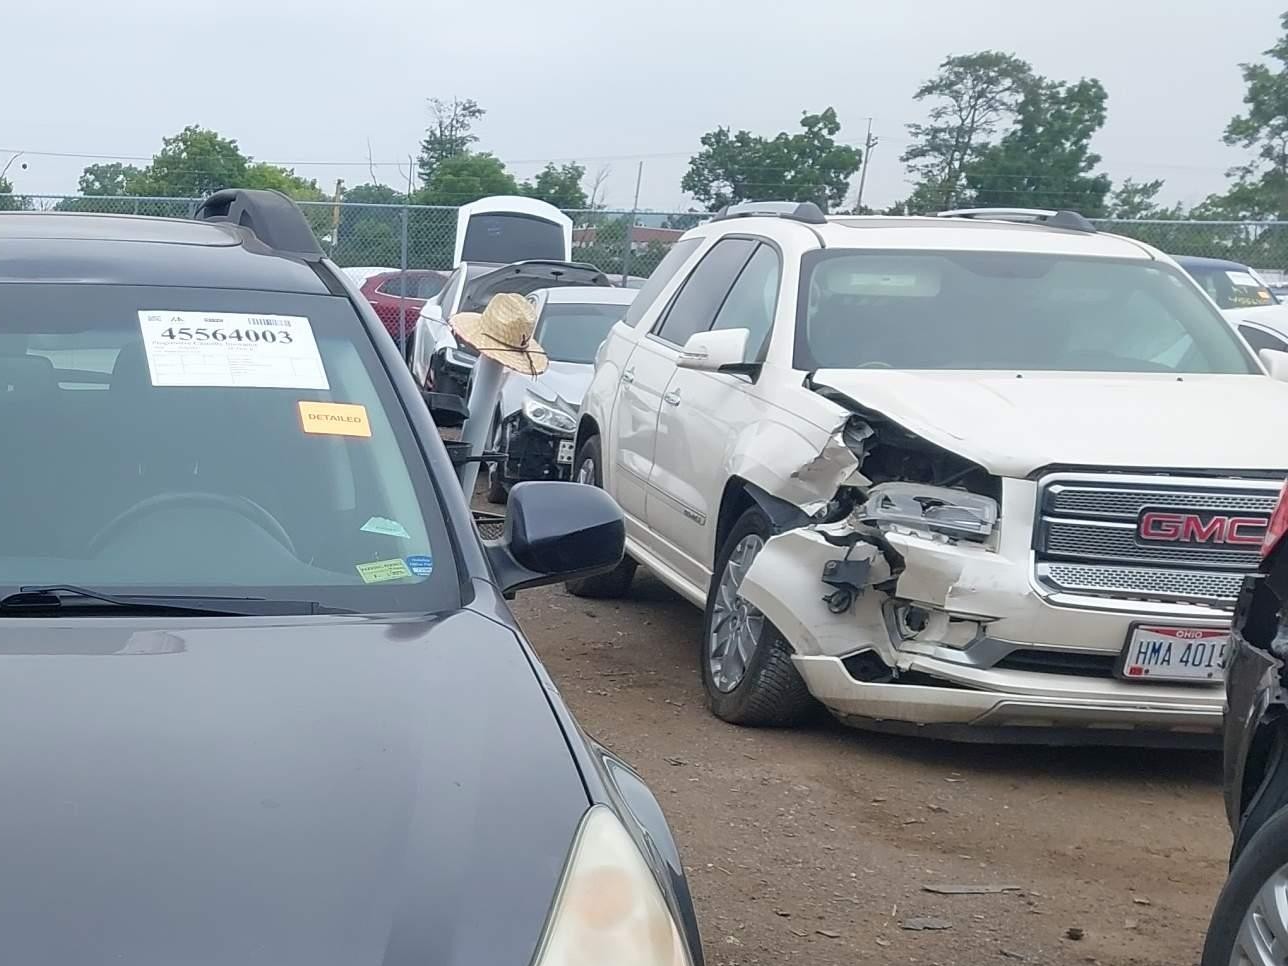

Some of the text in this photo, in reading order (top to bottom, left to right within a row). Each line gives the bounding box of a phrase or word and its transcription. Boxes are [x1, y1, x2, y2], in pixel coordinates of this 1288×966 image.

[161, 327, 294, 344] 45564003
[307, 413, 362, 423] DETAILED
[1141, 512, 1268, 544] GMC
[1176, 630, 1203, 639] OHIO
[1135, 641, 1173, 666] HMA
